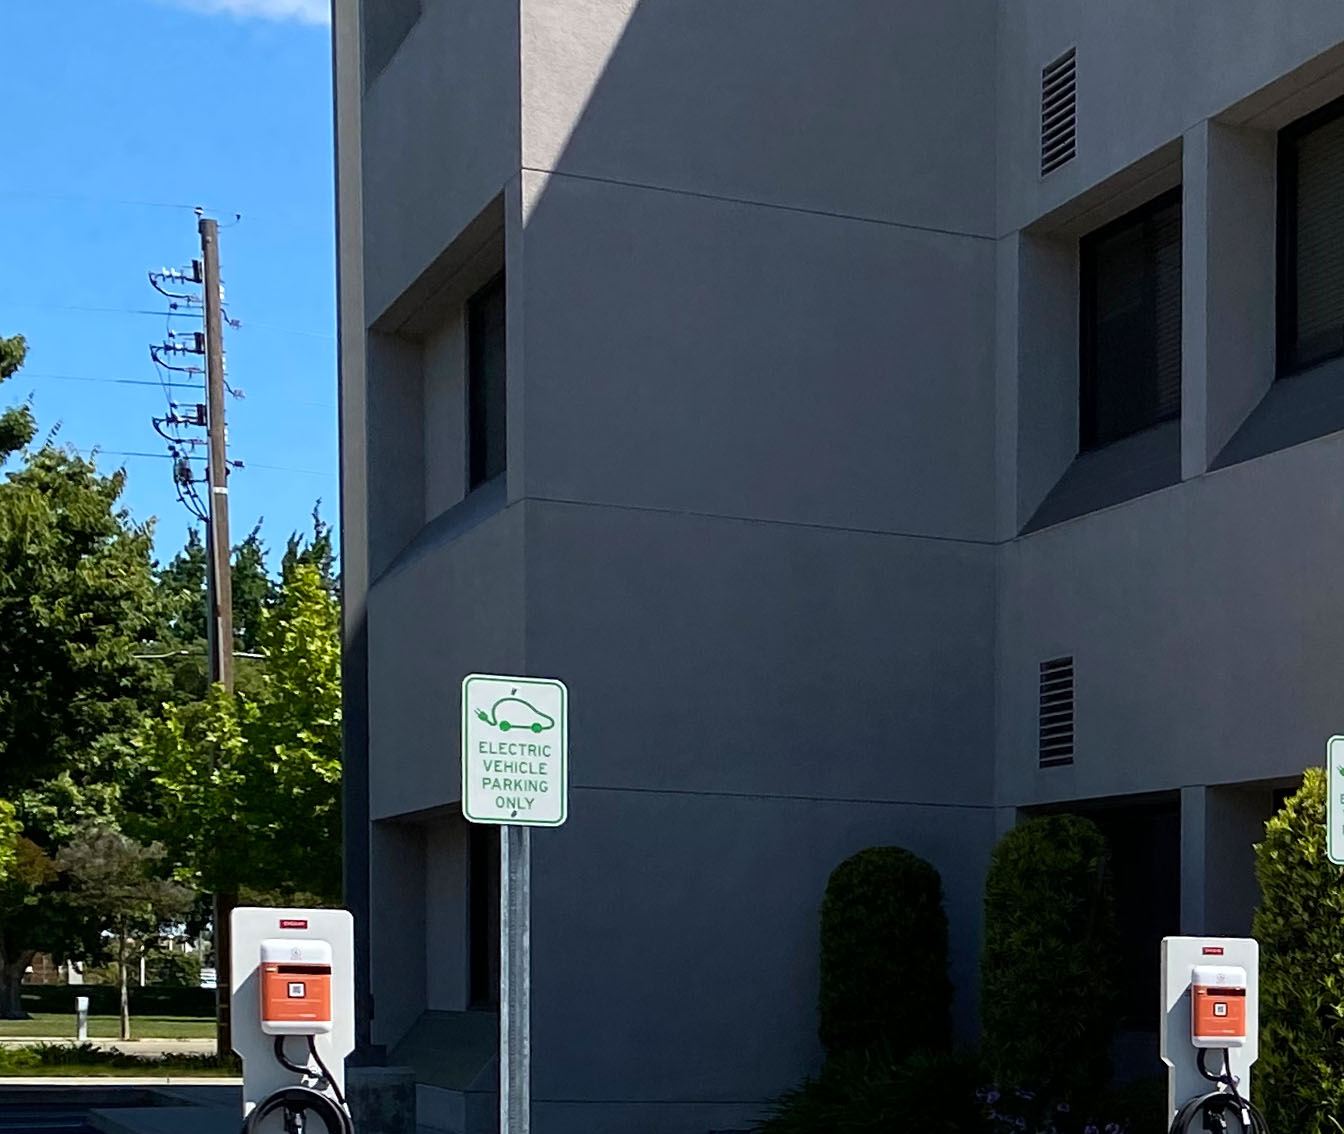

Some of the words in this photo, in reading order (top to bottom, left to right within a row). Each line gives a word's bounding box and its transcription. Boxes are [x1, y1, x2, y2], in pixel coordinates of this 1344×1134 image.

[478, 740, 552, 758] ELECTRIC
[482, 759, 549, 775] VEHICLE
[481, 777, 549, 793] PARKING
[495, 795, 535, 810] ONLY
